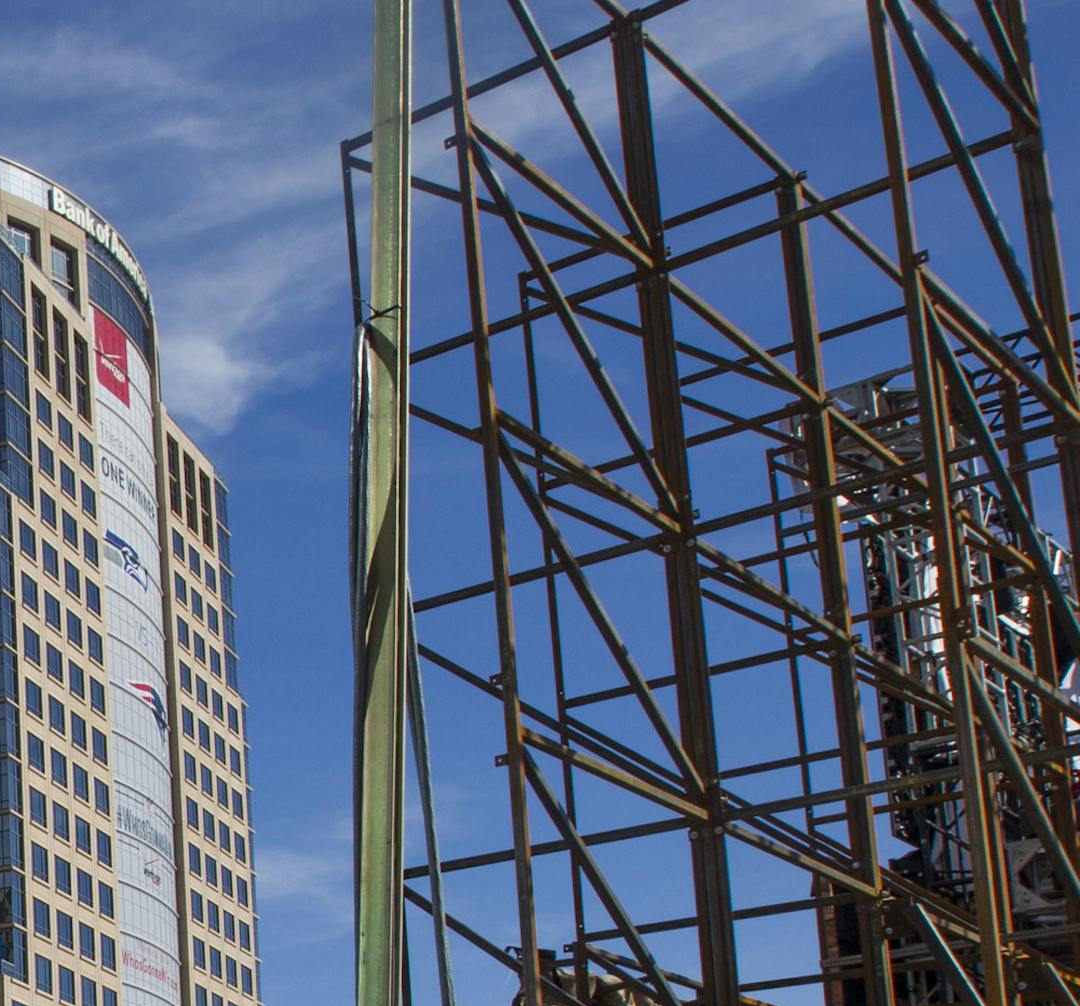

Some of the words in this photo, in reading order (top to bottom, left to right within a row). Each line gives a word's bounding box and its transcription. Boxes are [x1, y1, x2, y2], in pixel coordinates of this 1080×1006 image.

[50, 186, 97, 239] Bank
[95, 221, 111, 248] of
[101, 456, 125, 490] ONE
